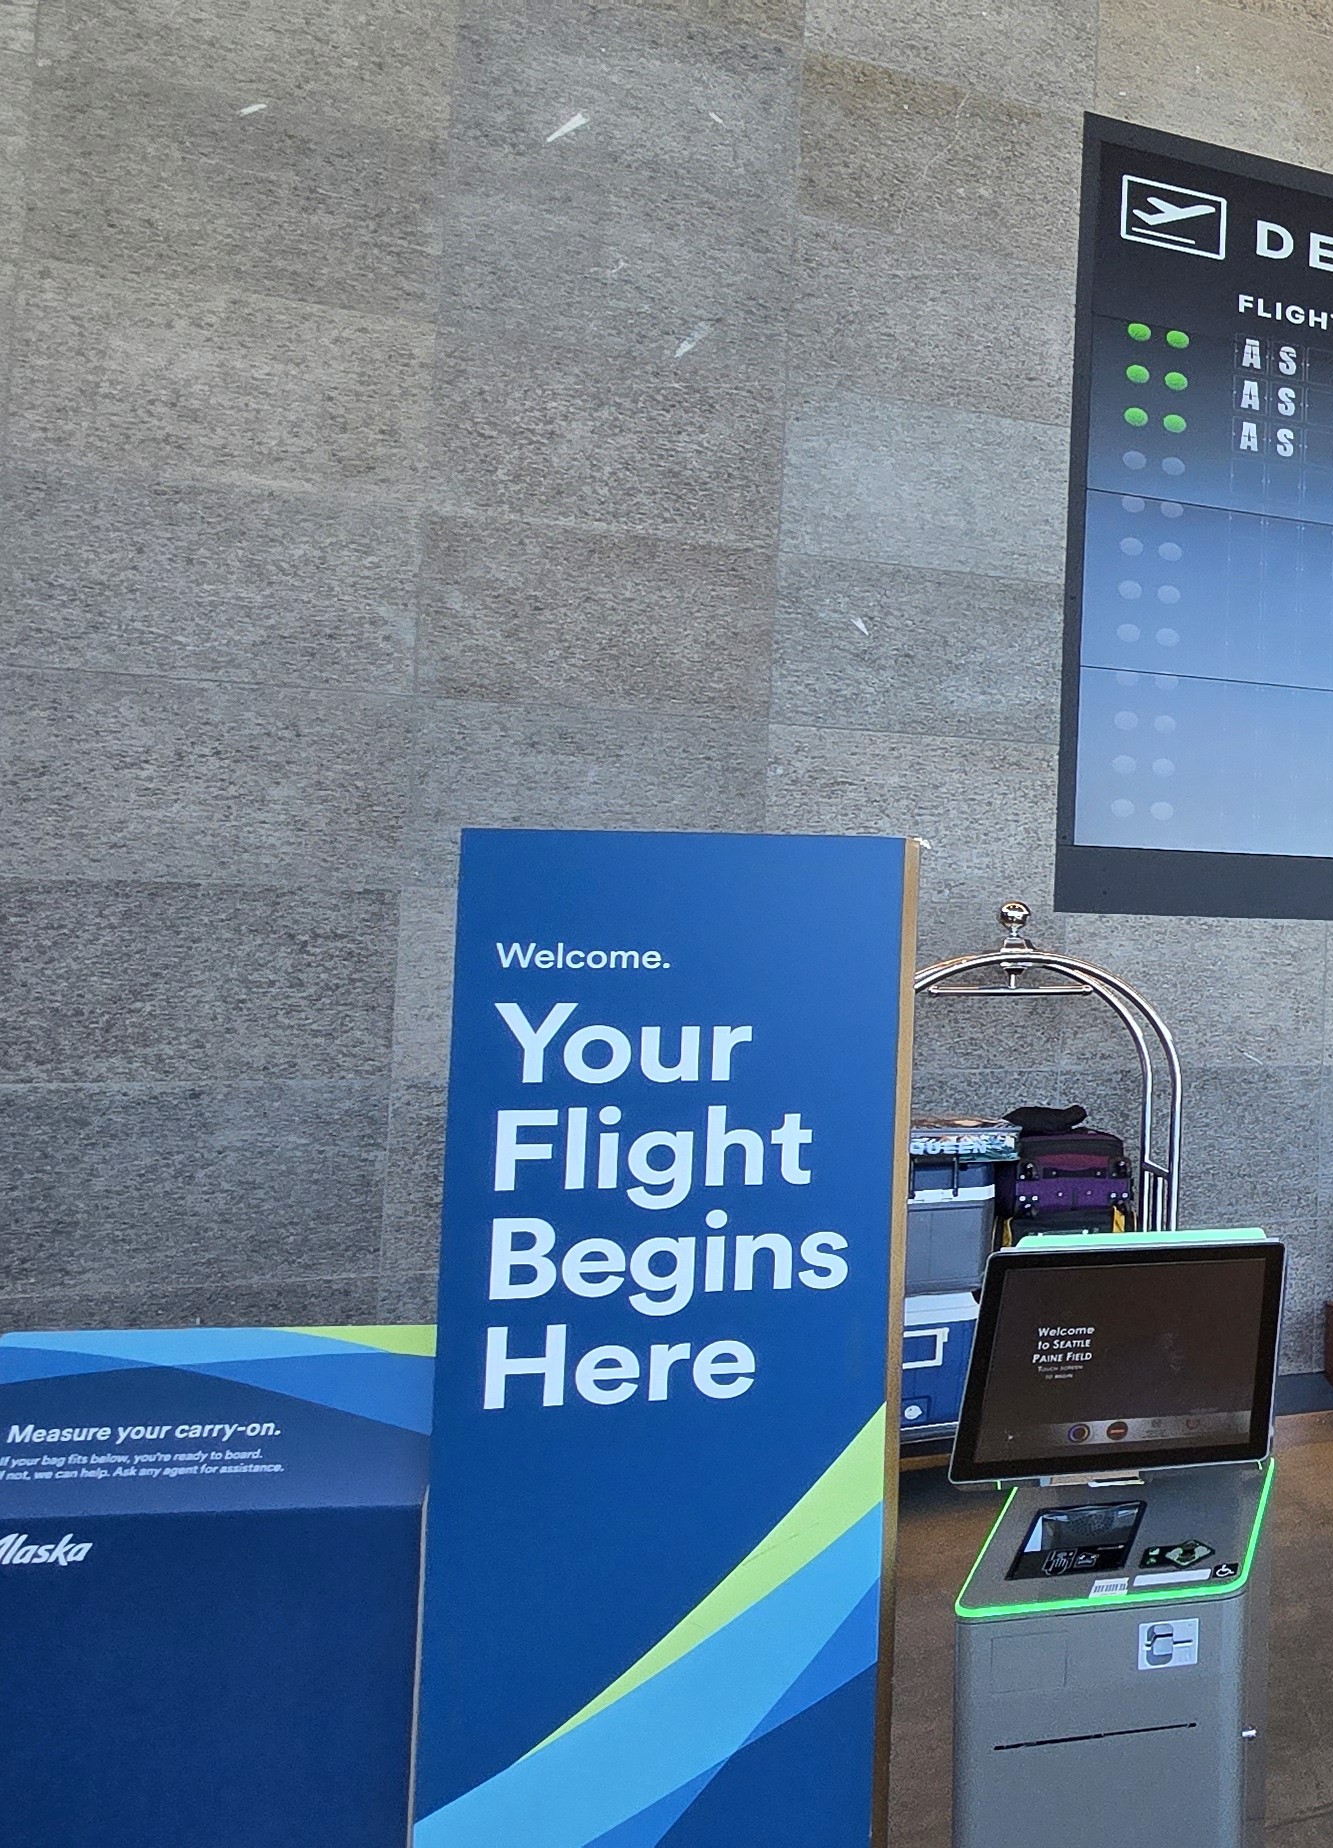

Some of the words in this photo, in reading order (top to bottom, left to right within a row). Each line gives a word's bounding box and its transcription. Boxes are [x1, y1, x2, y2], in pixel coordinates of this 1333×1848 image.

[1241, 338, 1297, 375] AS
[1240, 380, 1296, 416] AS
[1239, 421, 1294, 457] AS
[496, 942, 671, 969] Welcome.
[495, 1002, 753, 1084] Your
[494, 1105, 813, 1210] Flight
[488, 1209, 849, 1317] Begins
[1038, 1326, 1096, 1337] Welcome
[483, 1323, 756, 1410] Here
[1032, 1353, 1064, 1363] PAINE
[1066, 1352, 1093, 1361] FIELD
[6, 1425, 111, 1443] Measure
[115, 1424, 171, 1445] your
[175, 1421, 281, 1442] carry-on.
[10, 1457, 41, 1469] your
[41, 1455, 66, 1467] bag
[68, 1453, 88, 1464] fits
[173, 1450, 208, 1463] ready
[210, 1451, 222, 1460] to
[224, 1448, 263, 1460] board.
[34, 1471, 53, 1479] we
[55, 1470, 78, 1478] can
[112, 1466, 138, 1477] Ask
[138, 1467, 162, 1478] any
[162, 1465, 199, 1477] agent
[200, 1463, 219, 1474] for
[220, 1462, 285, 1474] assistance.
